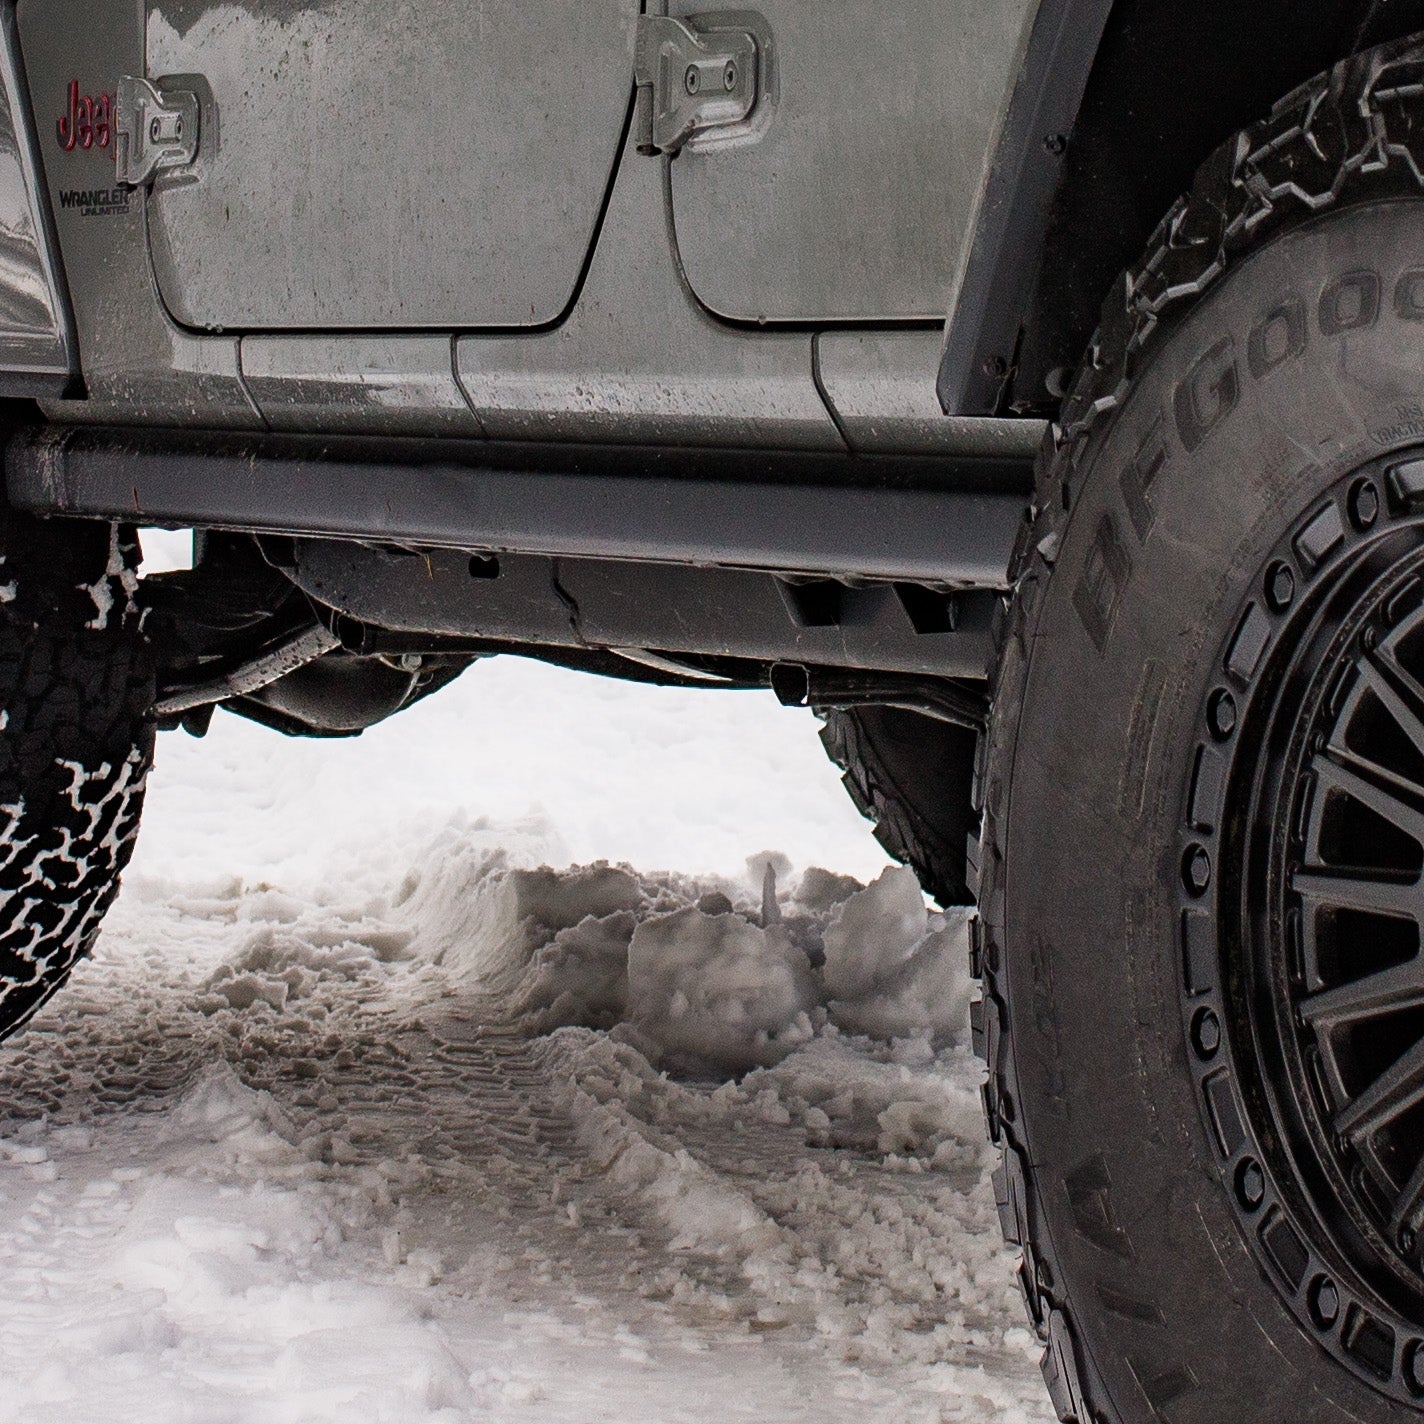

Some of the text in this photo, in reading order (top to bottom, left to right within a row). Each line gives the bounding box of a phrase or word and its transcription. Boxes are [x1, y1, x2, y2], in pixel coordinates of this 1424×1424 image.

[57, 79, 117, 165] Jee
[59, 189, 129, 208] WRANGLER
[80, 205, 130, 216] UNLIMITED
